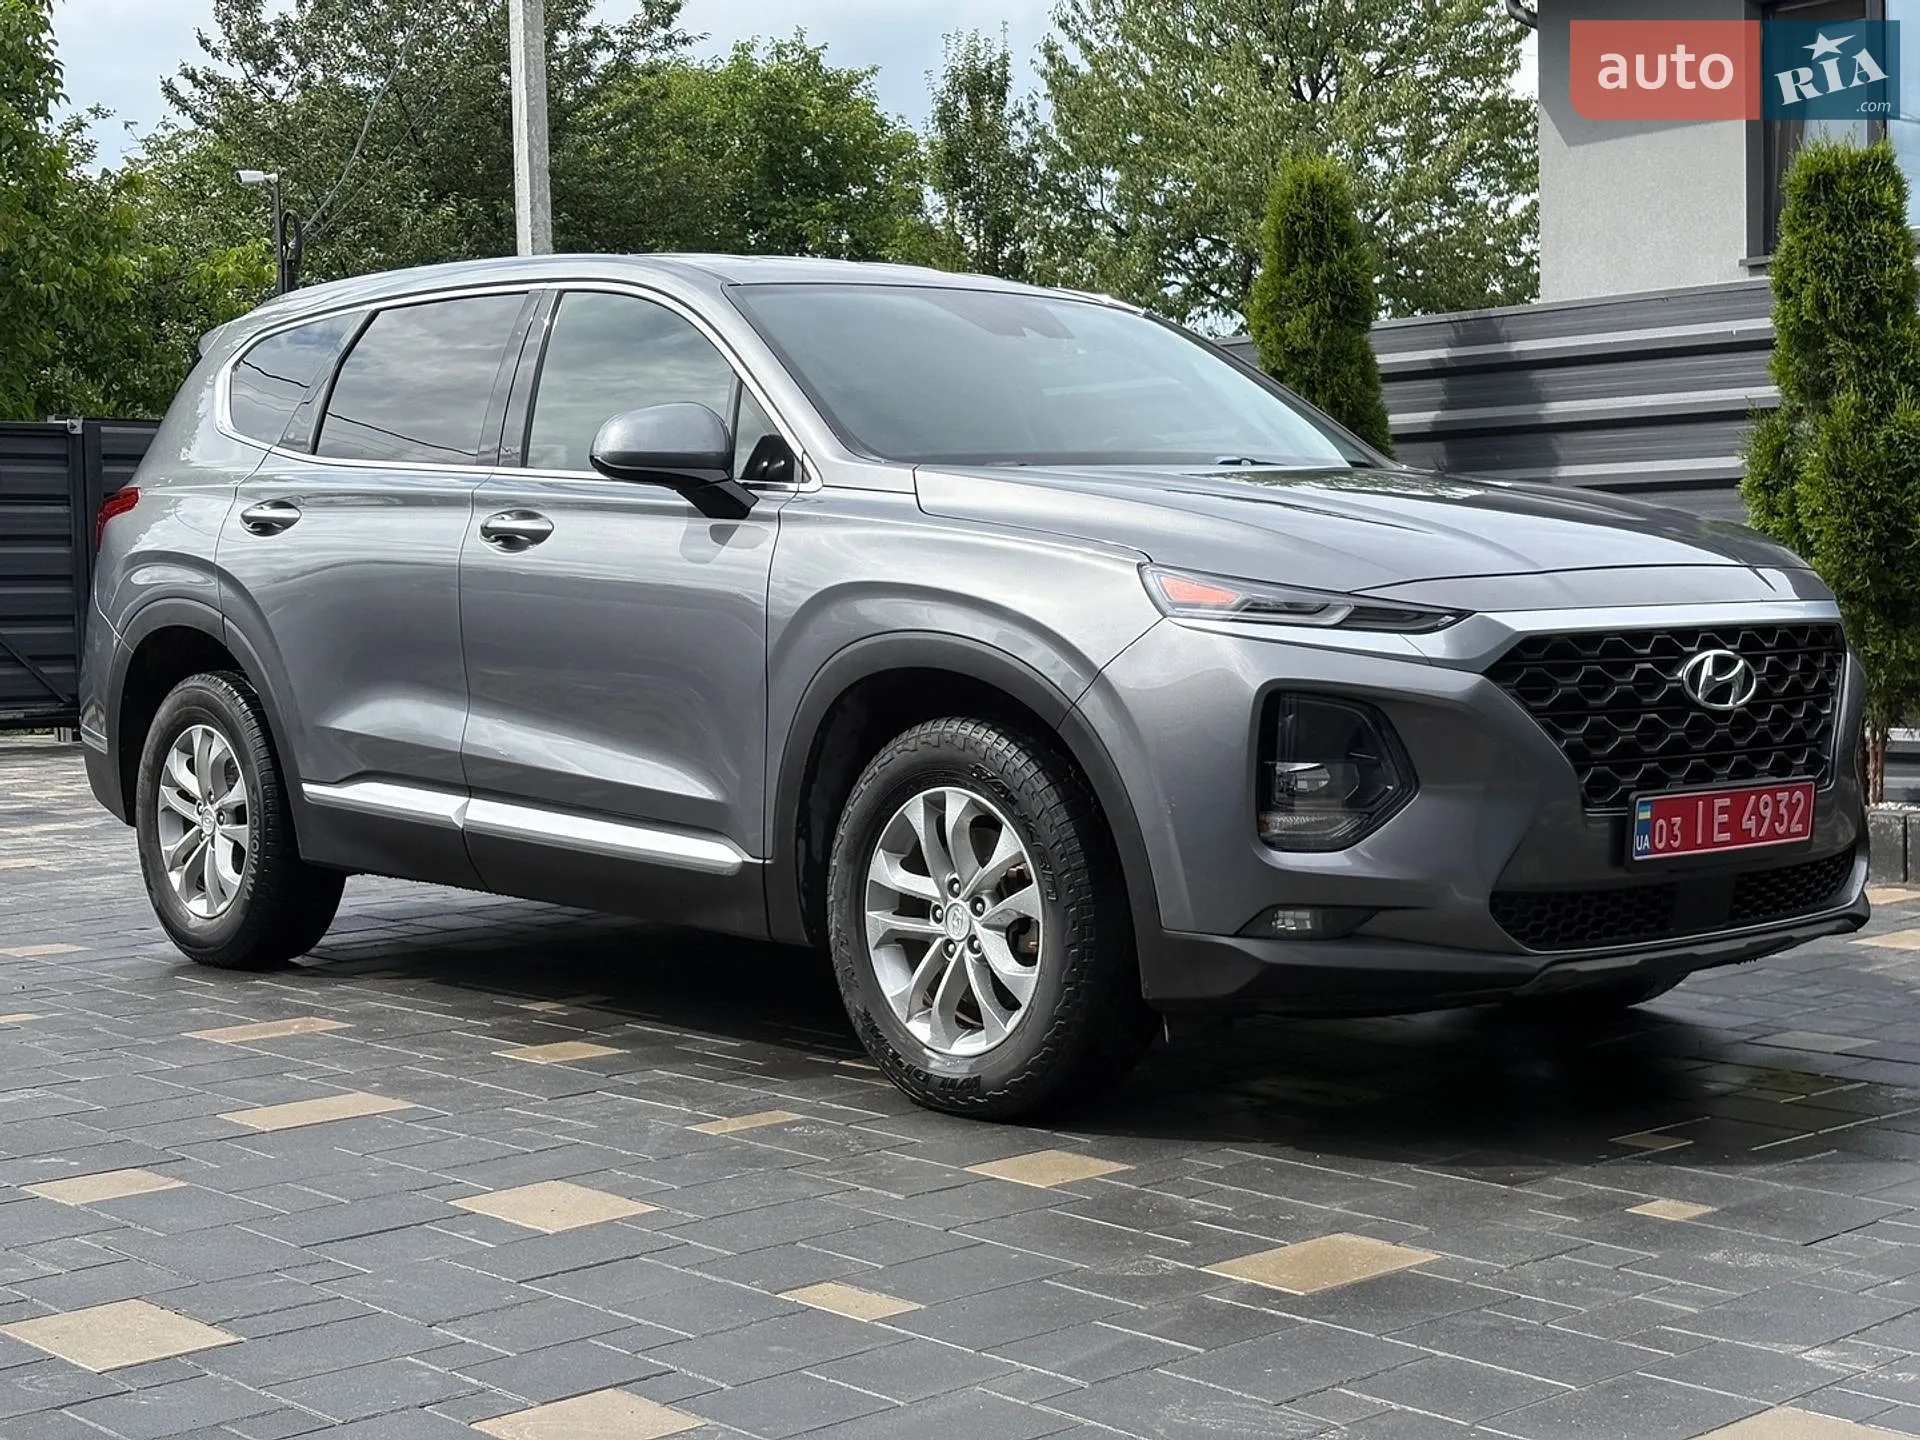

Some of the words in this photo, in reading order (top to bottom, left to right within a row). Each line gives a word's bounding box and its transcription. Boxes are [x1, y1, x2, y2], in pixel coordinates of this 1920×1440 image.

[1654, 816, 1682, 850] 03
[1696, 798, 1731, 845] IE
[1742, 790, 1805, 838] 4932
[1635, 833, 1650, 850] UA
